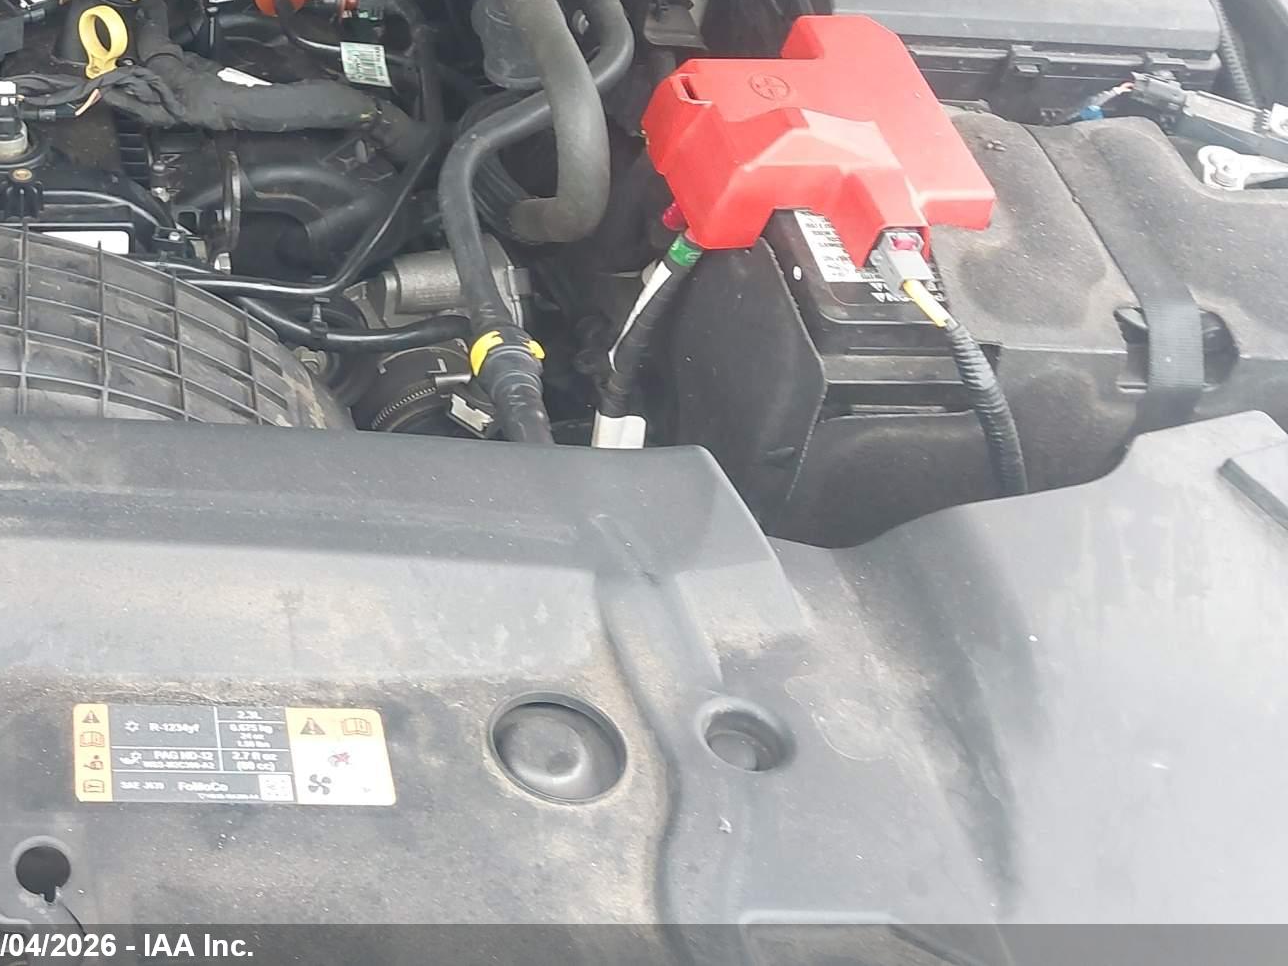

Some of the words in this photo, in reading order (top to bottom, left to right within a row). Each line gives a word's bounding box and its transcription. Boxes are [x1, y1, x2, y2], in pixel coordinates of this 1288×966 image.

[236, 710, 263, 720] 2.3L
[149, 722, 200, 735] R-1234yf
[153, 751, 178, 760] PAG
[232, 751, 249, 761] 2.7
[120, 781, 141, 790] SAE
[177, 781, 229, 792] FoMoCo
